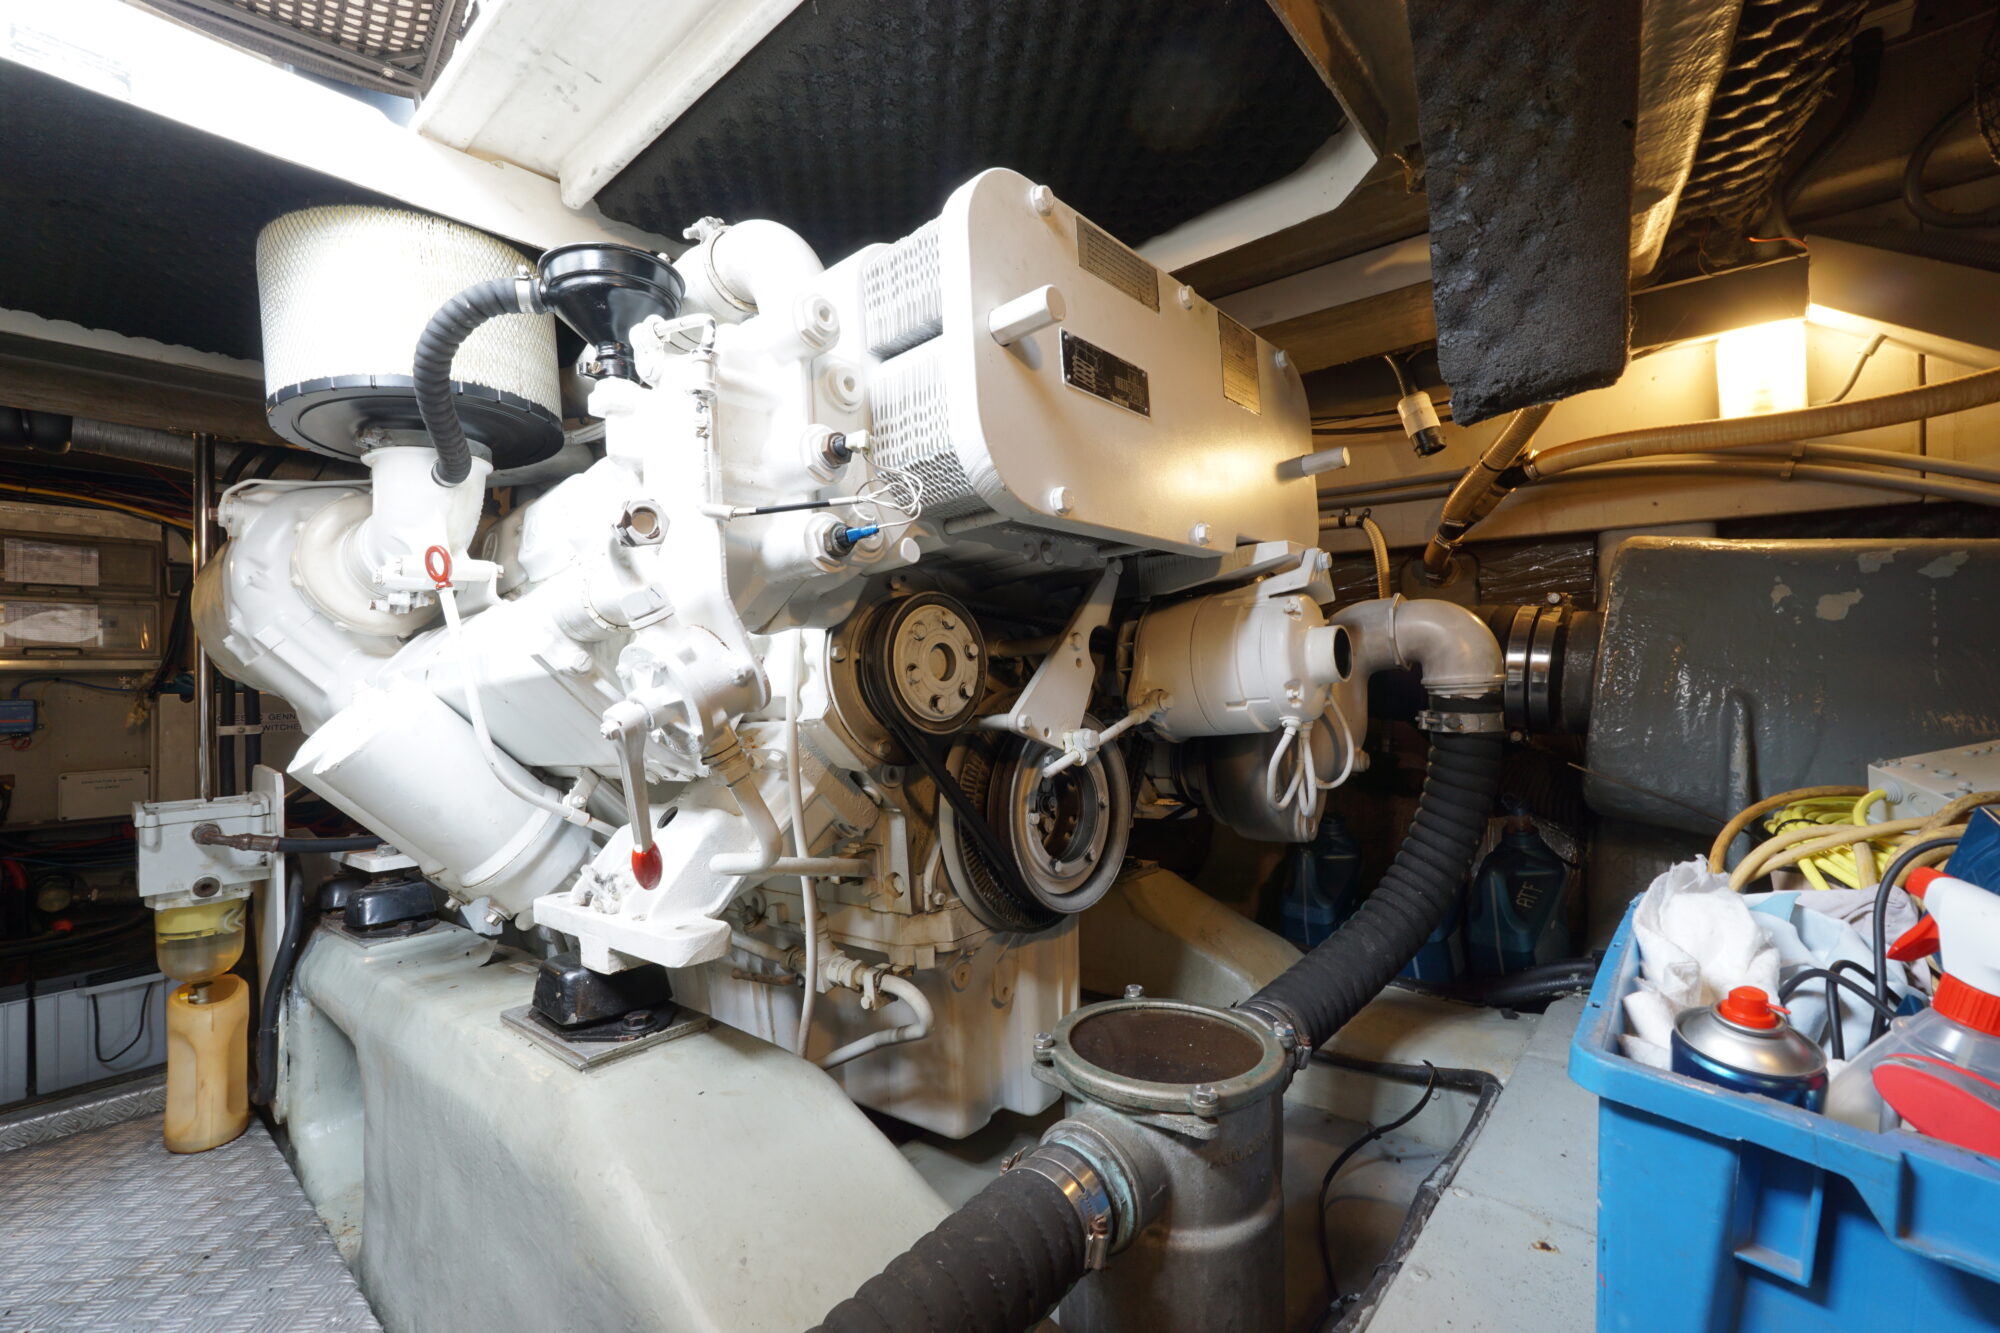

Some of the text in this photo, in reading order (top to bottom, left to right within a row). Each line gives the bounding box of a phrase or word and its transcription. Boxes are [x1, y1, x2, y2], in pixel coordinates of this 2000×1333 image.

[268, 713, 296, 721] GENN
[263, 723, 300, 731] WITCHE
[1516, 881, 1543, 908] ATF
